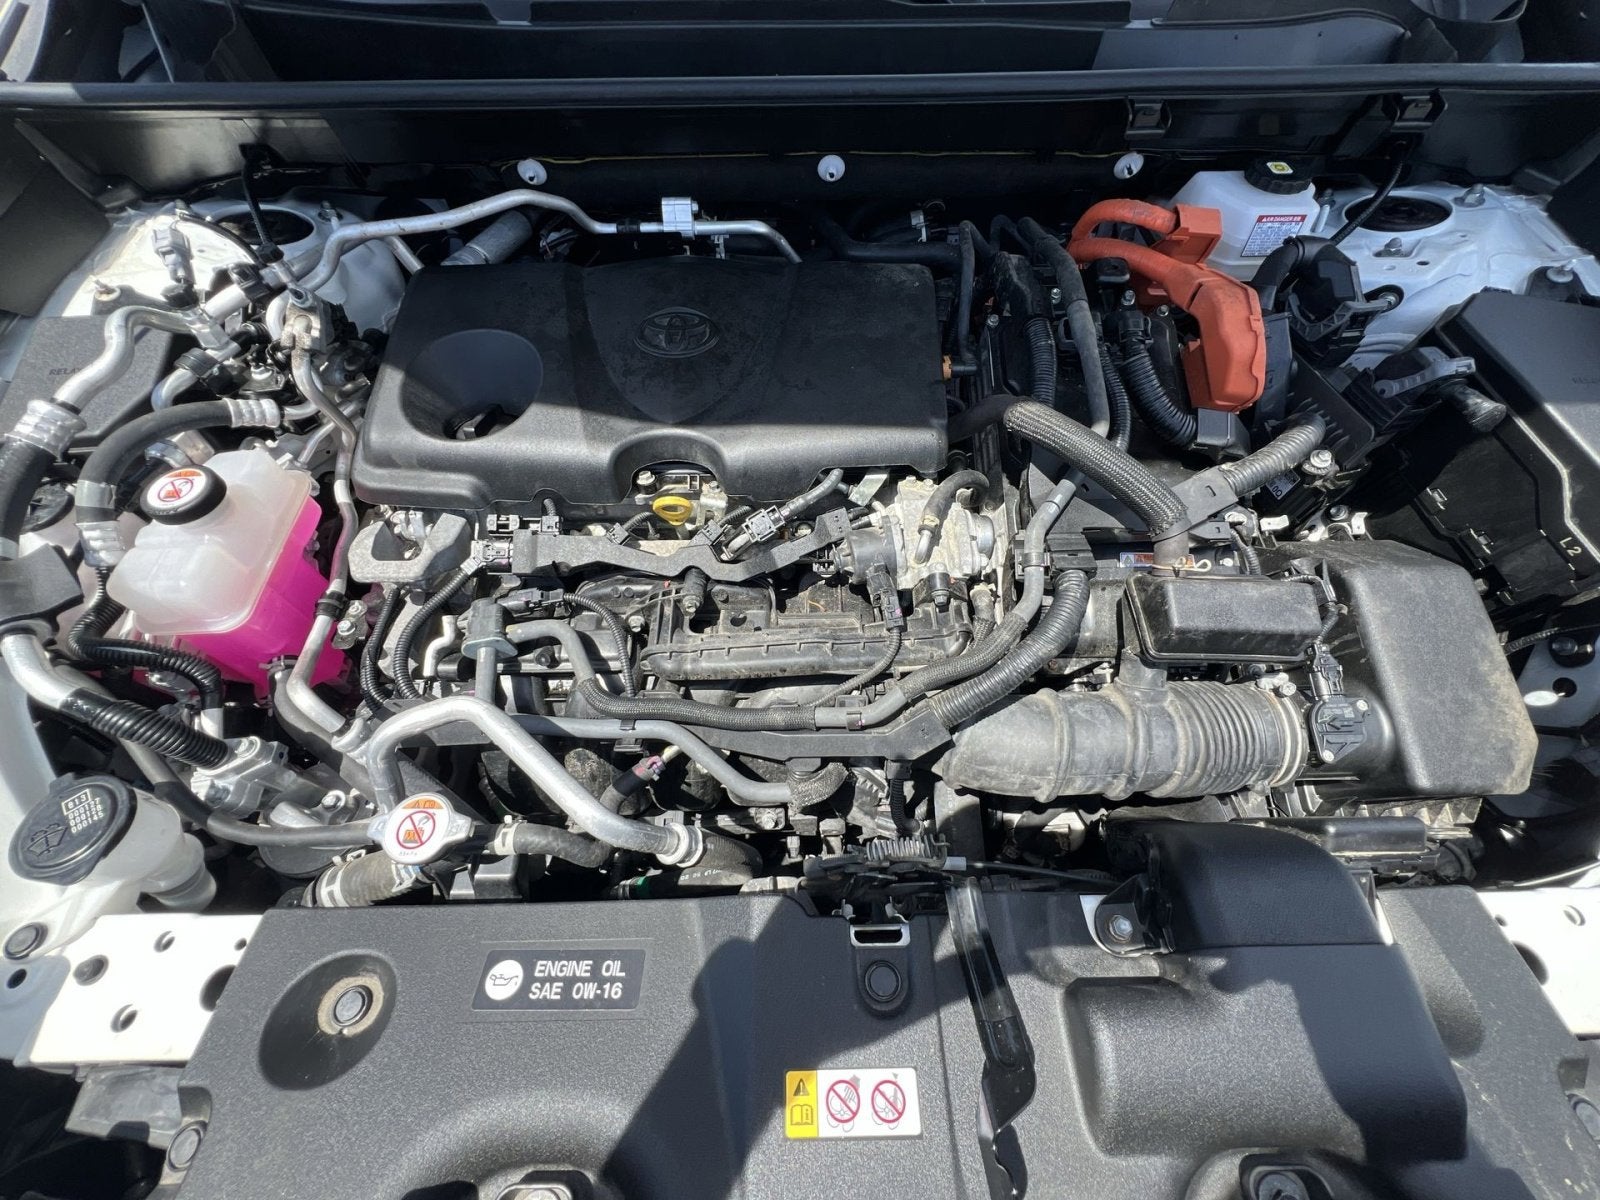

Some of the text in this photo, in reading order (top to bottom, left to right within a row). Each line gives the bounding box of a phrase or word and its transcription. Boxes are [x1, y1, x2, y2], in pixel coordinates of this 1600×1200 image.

[1559, 536, 1582, 557] L2
[534, 960, 626, 977] ENGINE OIL
[528, 982, 564, 1000] SAE
